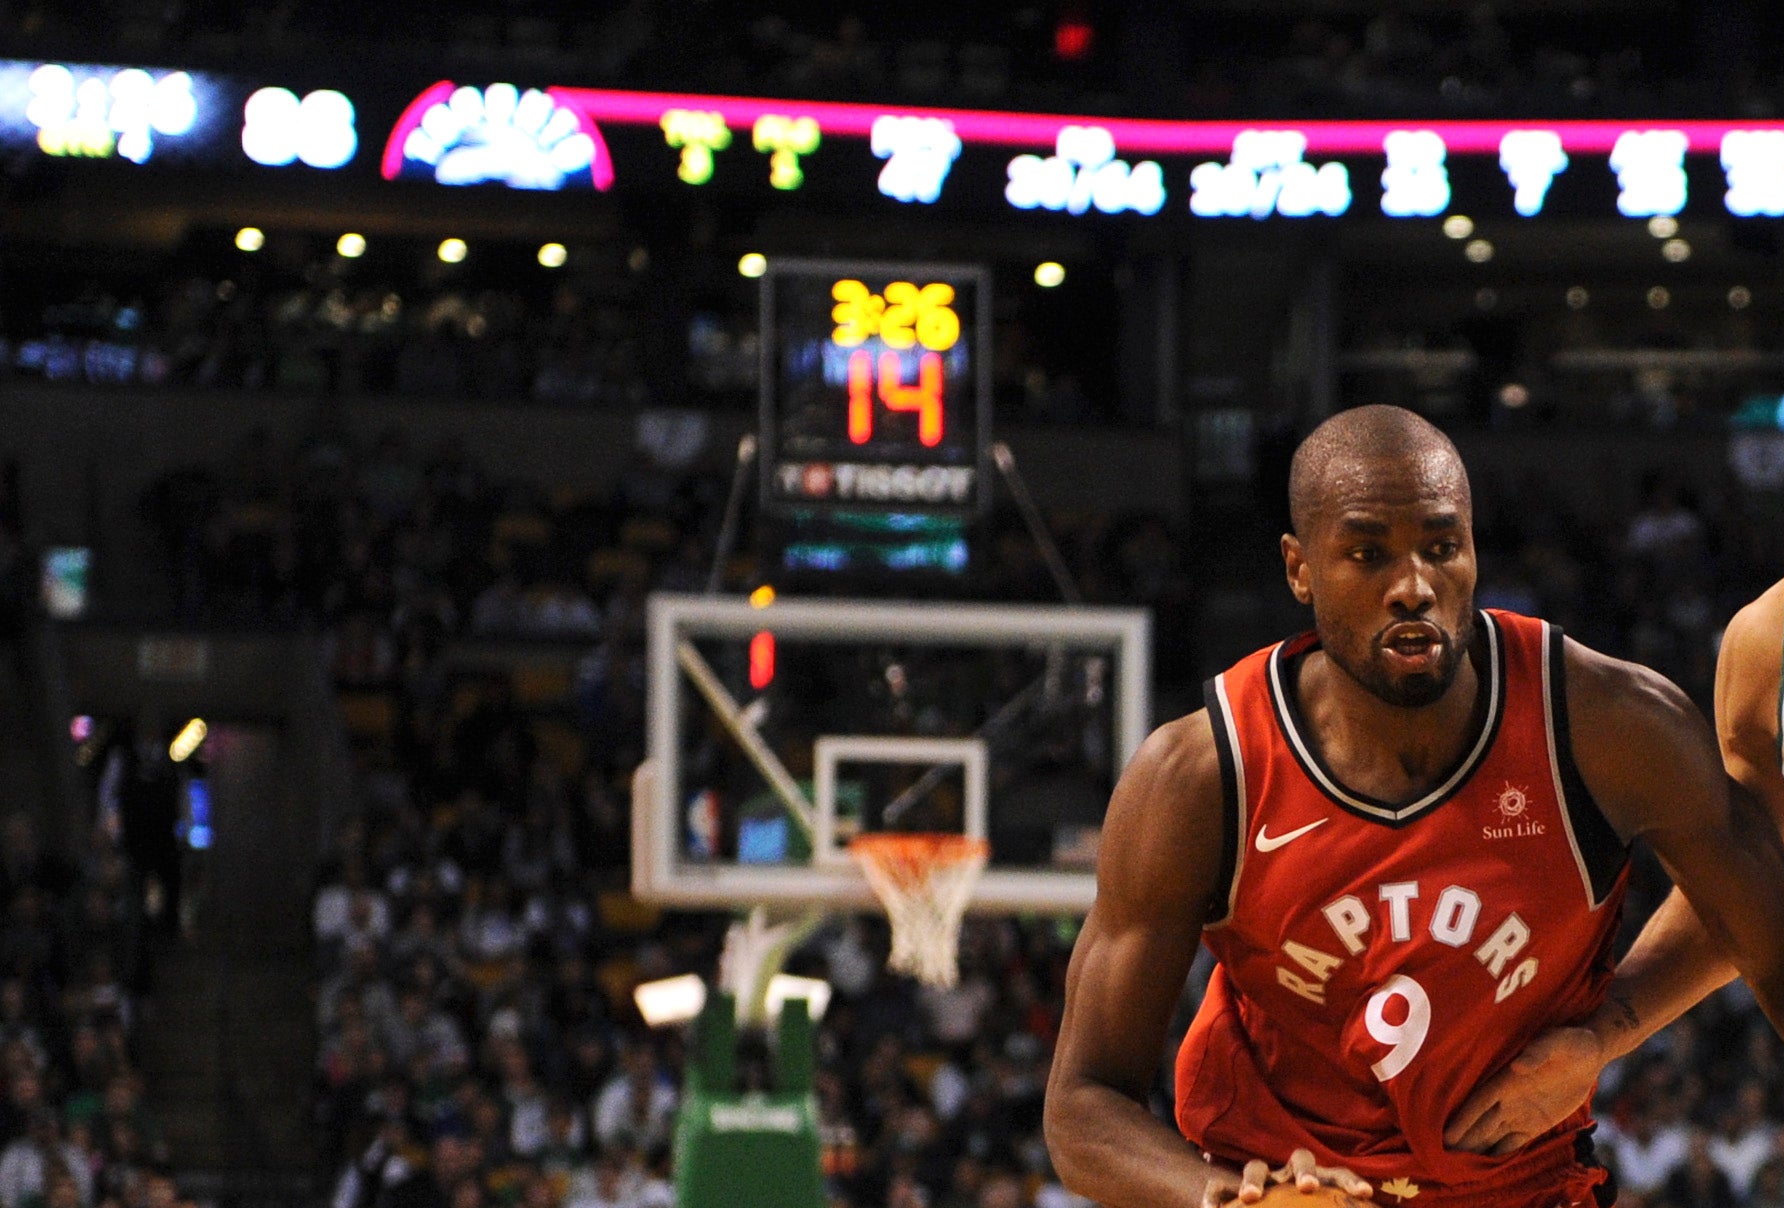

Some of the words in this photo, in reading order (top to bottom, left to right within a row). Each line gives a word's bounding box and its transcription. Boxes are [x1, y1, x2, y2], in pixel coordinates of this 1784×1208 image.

[832, 279, 960, 351] 3:26
[847, 349, 944, 448] 14
[1482, 826, 1513, 840] Sun
[1517, 820, 1546, 837] Life
[1276, 880, 1540, 1005] RAPTORS
[1364, 974, 1432, 1082] 9
